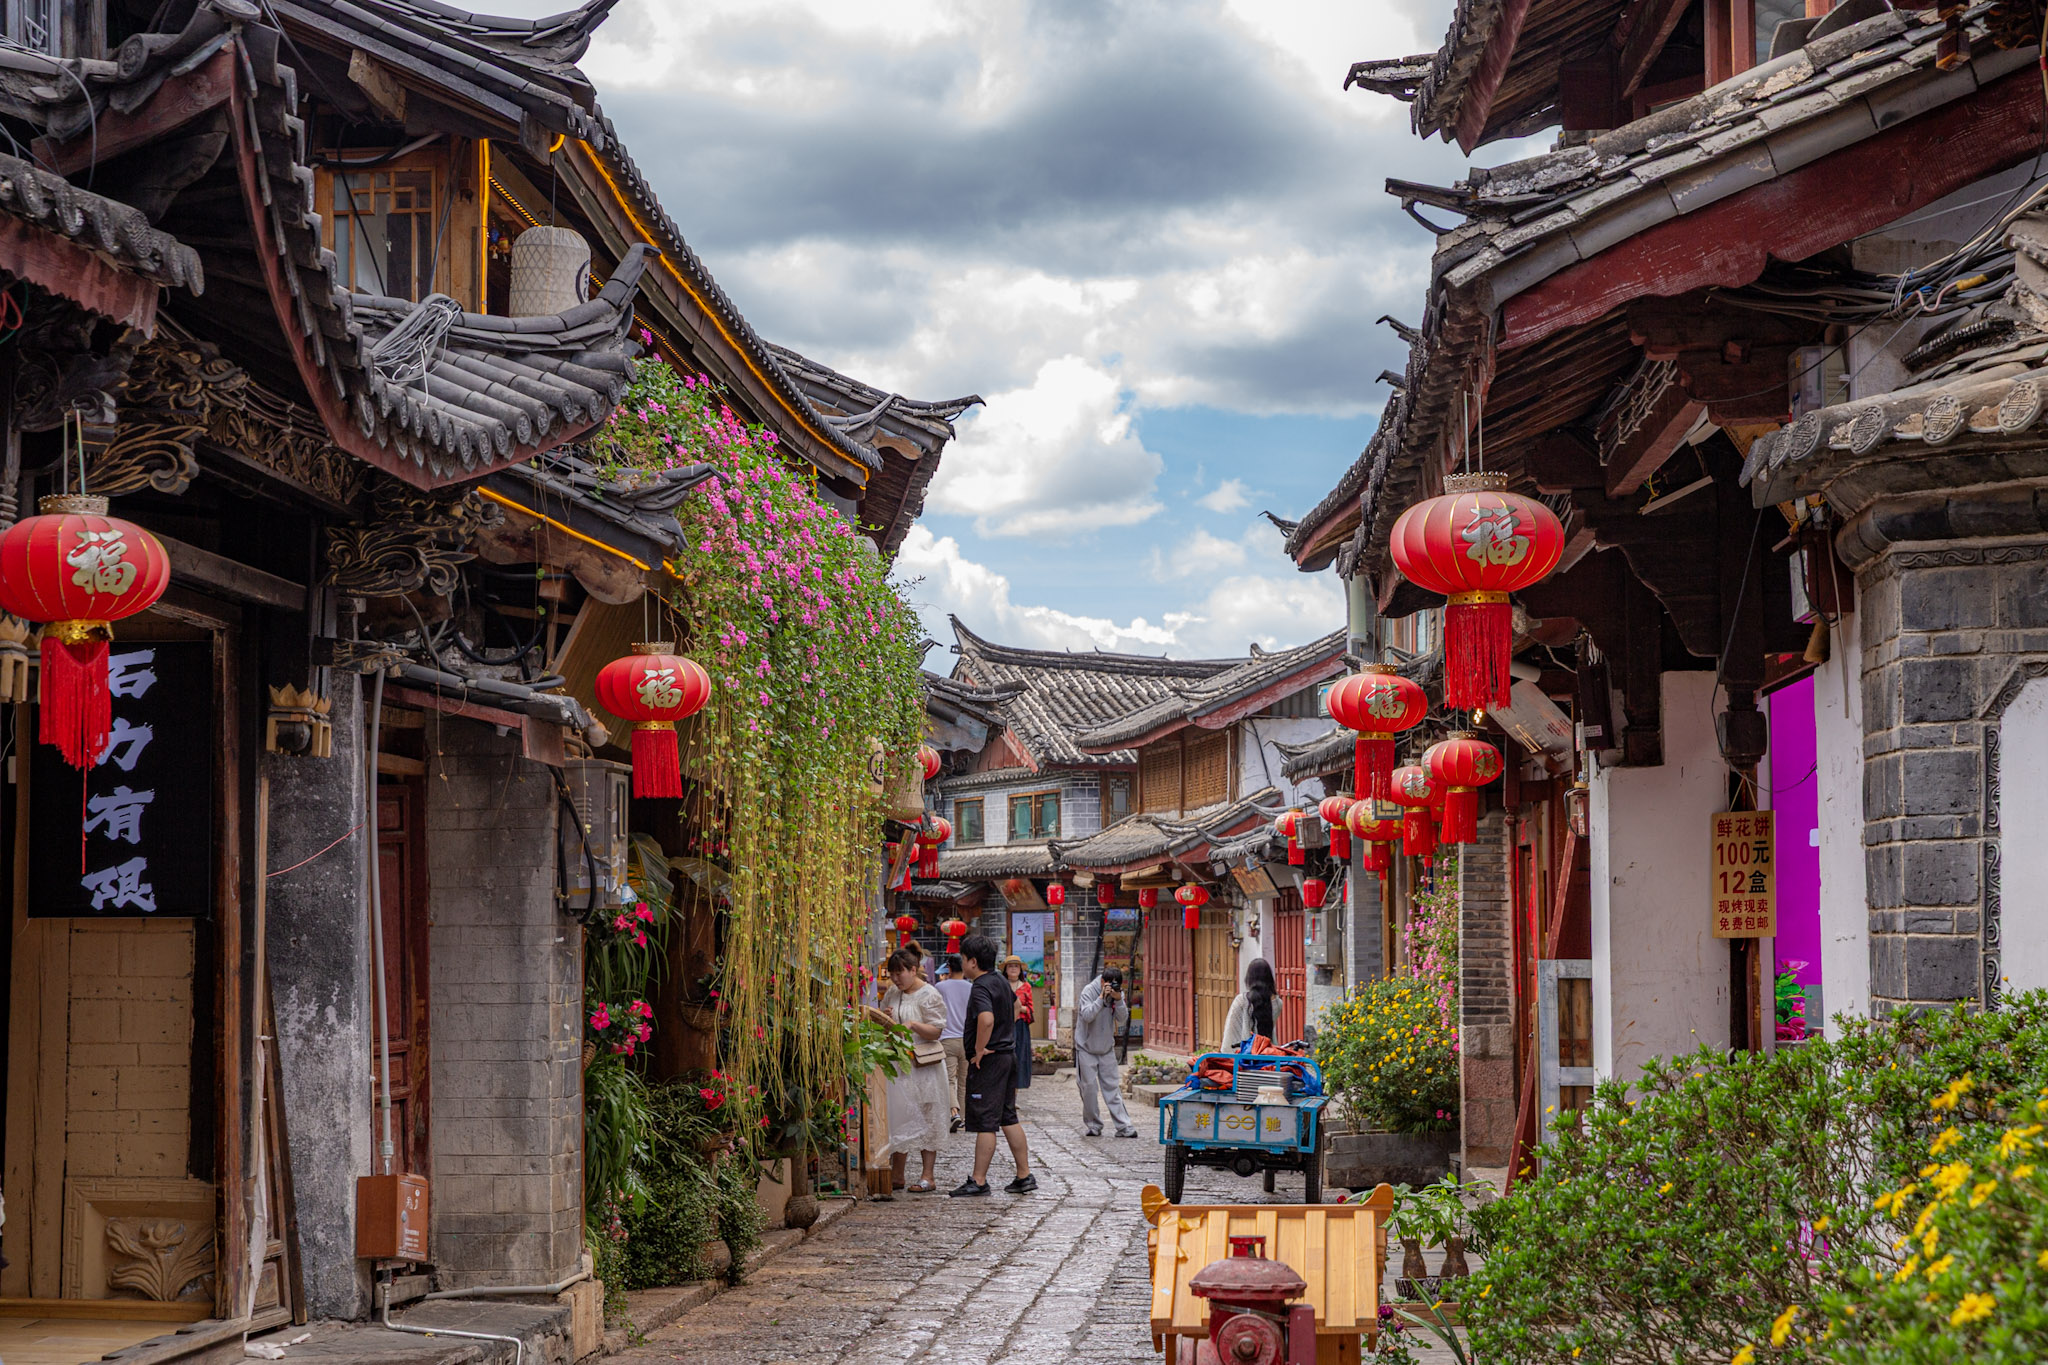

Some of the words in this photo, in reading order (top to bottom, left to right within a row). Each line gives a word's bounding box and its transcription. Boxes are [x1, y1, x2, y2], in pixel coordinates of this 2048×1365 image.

[1461, 504, 1530, 569] 福
[66, 529, 137, 596] 福
[635, 668, 684, 710] 福
[1364, 683, 1407, 720] 福
[1402, 773, 1431, 799] 福
[1717, 817, 1770, 838] 鲜花饼
[1716, 840, 1770, 866] 100元
[1719, 870, 1767, 894] 12盒
[1718, 898, 1769, 914] 现烤现卖
[1719, 916, 1769, 931] 免费包邮
[1195, 1112, 1211, 1129] 祥
